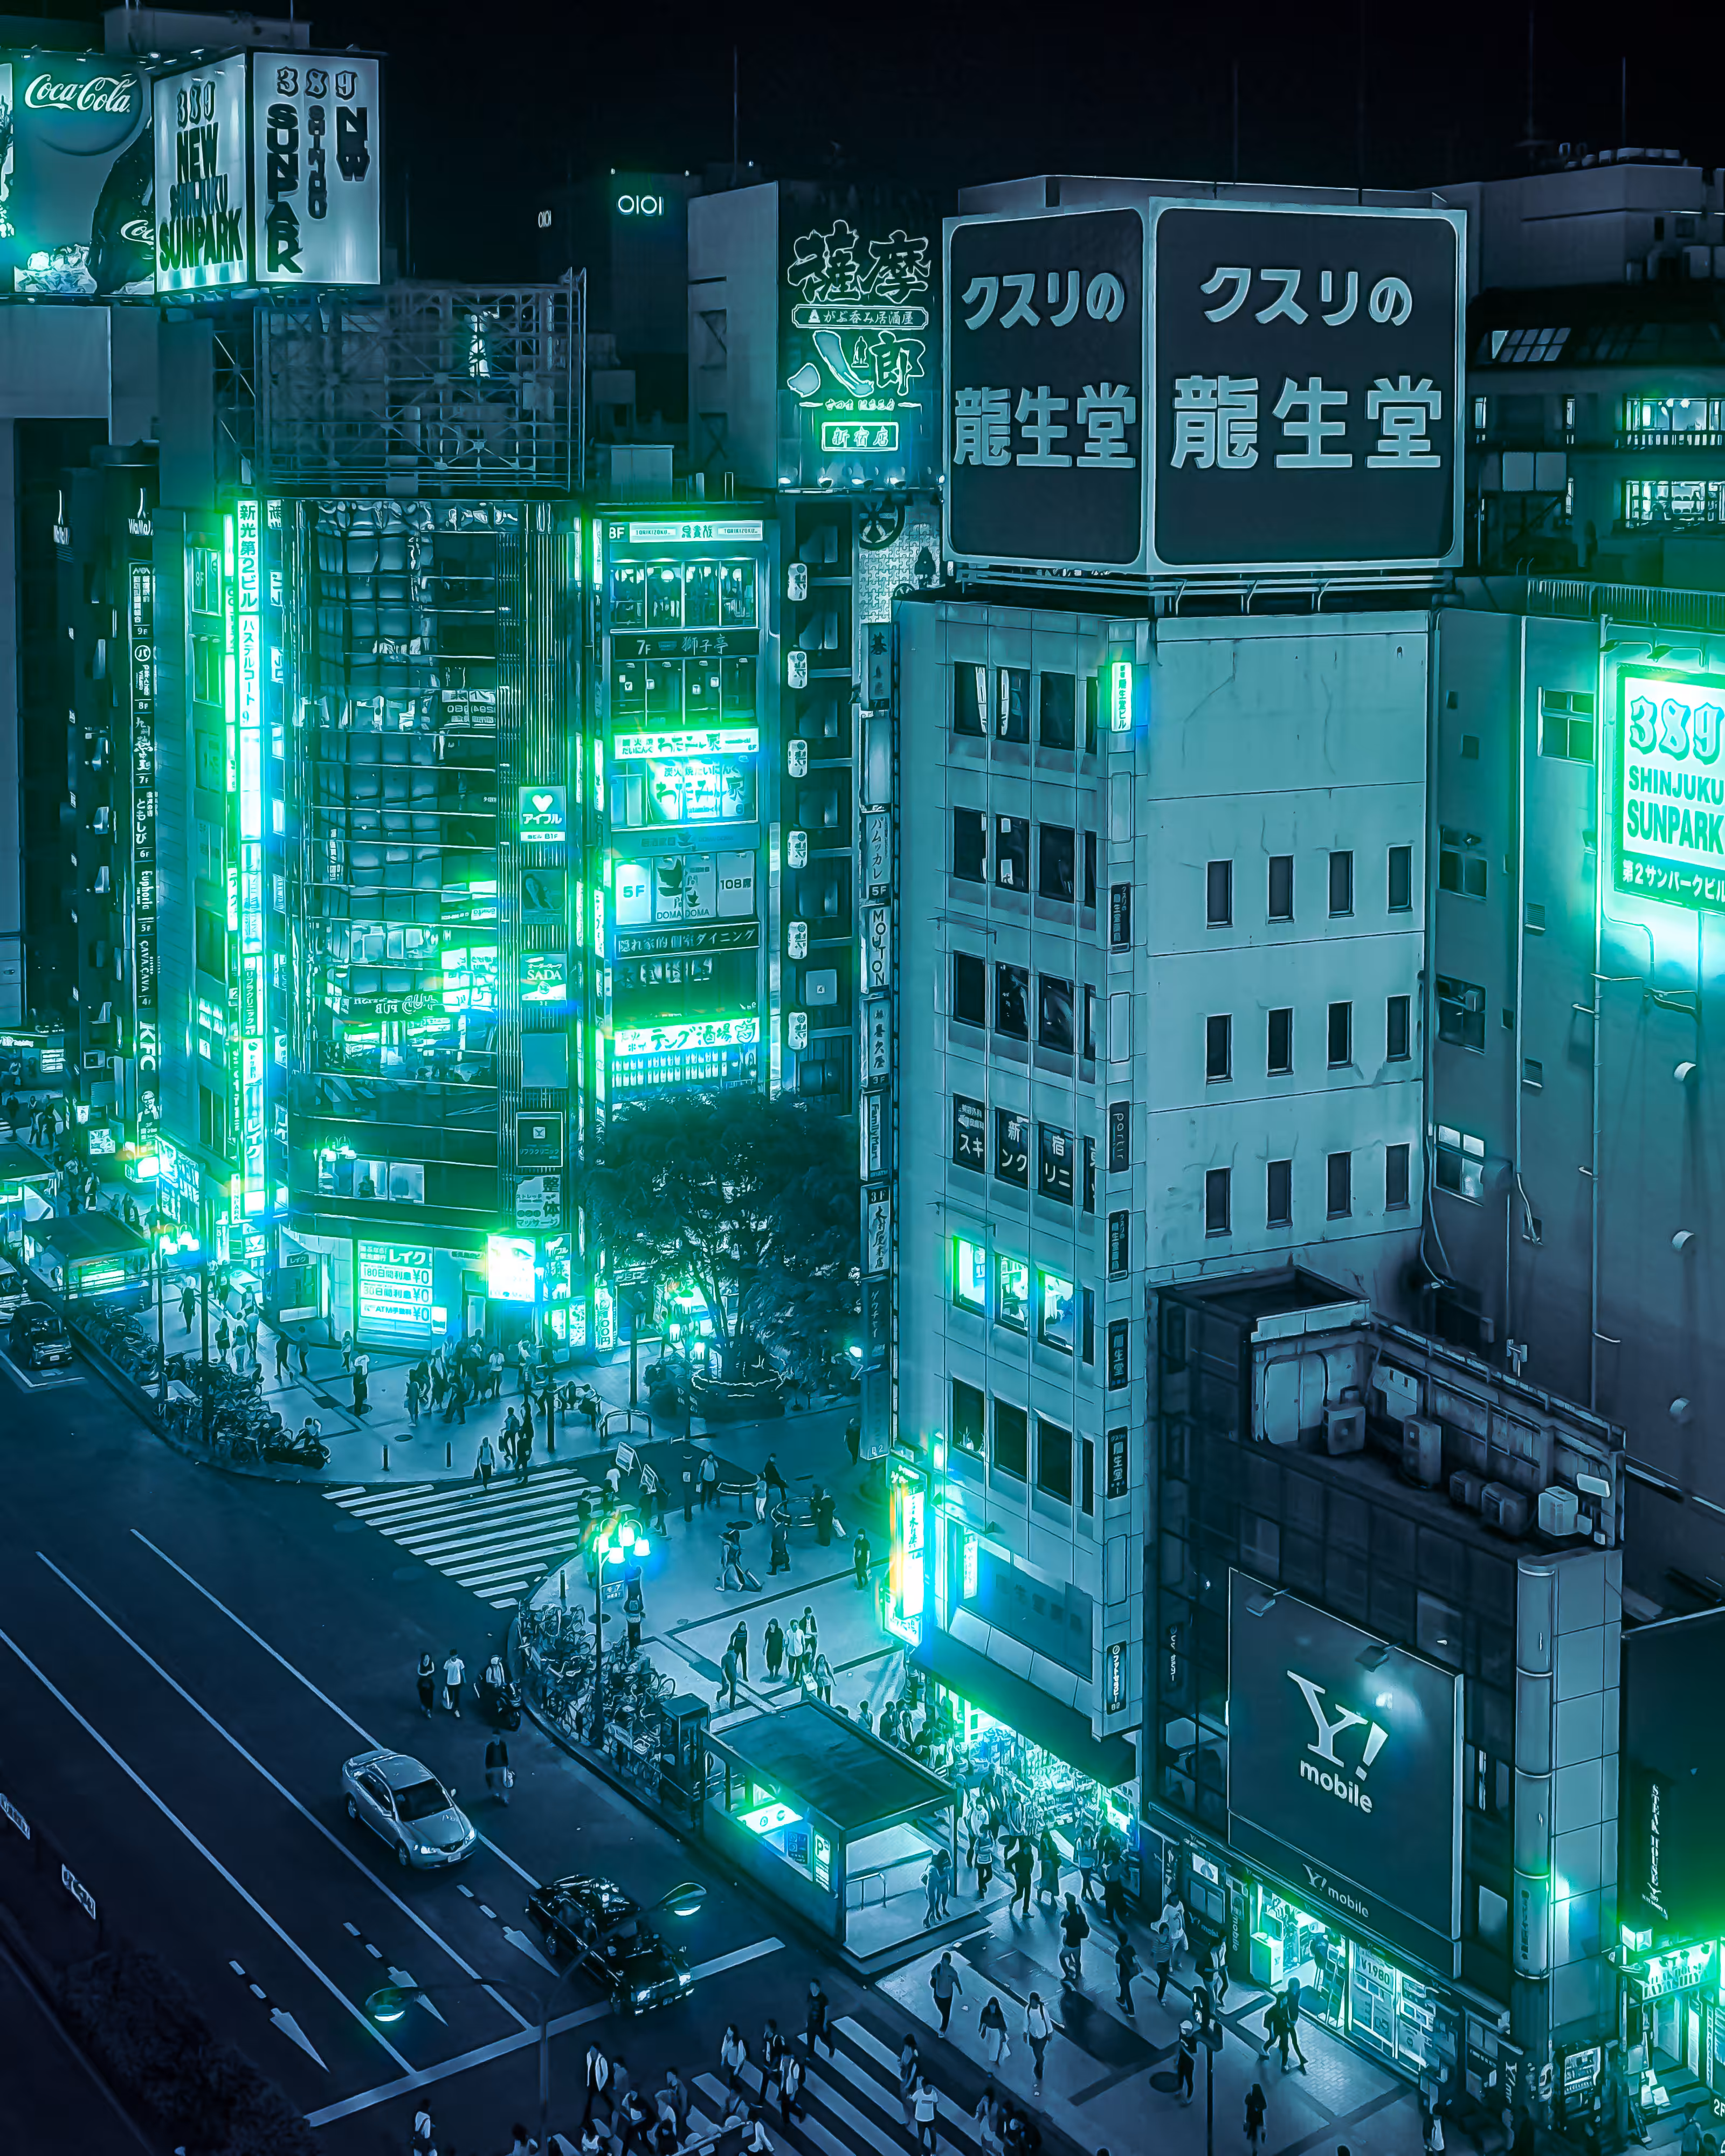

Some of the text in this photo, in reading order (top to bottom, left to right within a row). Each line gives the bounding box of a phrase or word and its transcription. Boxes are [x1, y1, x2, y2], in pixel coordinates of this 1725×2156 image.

[25, 74, 137, 113] Coca-Cola
[277, 66, 358, 101] 389
[176, 122, 219, 184] NEW
[160, 208, 244, 272] SUNPARK
[961, 270, 1125, 330] クスリの
[1200, 267, 1413, 327] クスリの
[832, 426, 889, 448] 新宿店
[954, 382, 1136, 468] 龍生堂
[1170, 376, 1442, 470] 龍生堂
[609, 527, 625, 539] 8F
[239, 505, 258, 609] 新光第2ビル
[137, 627, 148, 635] 9F
[637, 639, 651, 655] 7F
[139, 702, 148, 710] 8F
[1630, 695, 1725, 765] 389
[139, 776, 149, 784] 7F
[1628, 765, 1725, 806] SHINJUKU
[135, 798, 147, 845] ともしび
[522, 813, 562, 825] アイフル
[1627, 799, 1725, 855] SUNPARK
[870, 816, 885, 880] パムッカレ
[623, 884, 646, 898] 5F
[871, 886, 887, 897] 5F
[141, 924, 151, 932] 5F
[657, 908, 710, 920] DOMA DOMA
[527, 969, 563, 980] SADA
[142, 998, 151, 1006] 4F
[139, 1021, 156, 1072] KFC
[872, 1076, 886, 1085] 3F
[1113, 1112, 1126, 1159] partir
[871, 1189, 886, 1203] 3F
[413, 1269, 430, 1284] ¥0
[413, 1287, 430, 1302] ¥0
[413, 1306, 430, 1322] ¥0
[1287, 1670, 1389, 1781] Y!
[1300, 1759, 1372, 1813] mobile
[1302, 1863, 1369, 1918] Y! mobile
